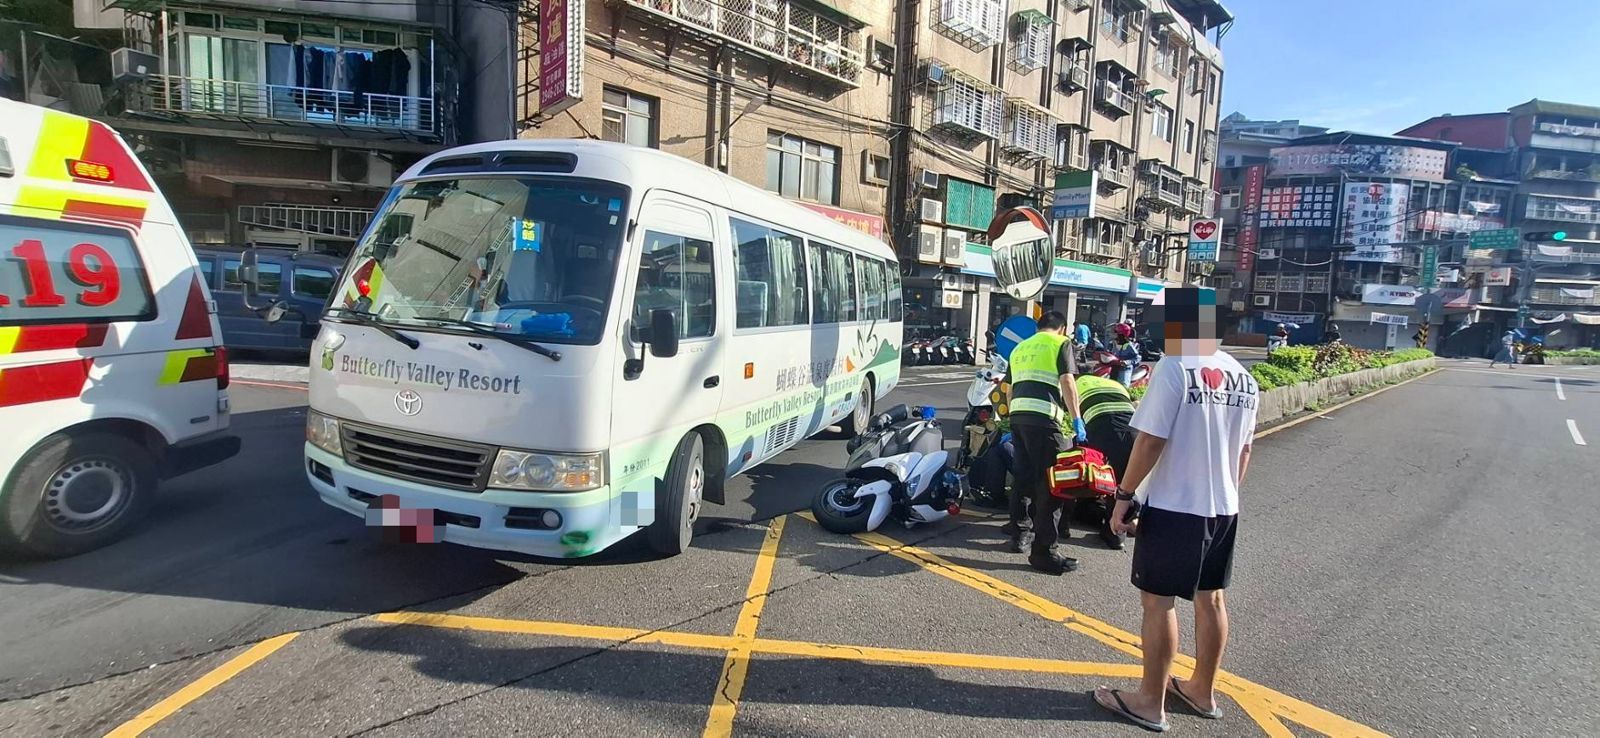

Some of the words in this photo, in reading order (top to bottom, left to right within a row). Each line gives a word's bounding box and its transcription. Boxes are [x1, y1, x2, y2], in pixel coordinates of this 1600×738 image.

[0, 239, 121, 307] 19
[341, 354, 402, 385] Butterfly
[407, 362, 454, 391] Valley
[458, 368, 521, 395] Resort
[1186, 367, 1200, 390] I
[1225, 369, 1256, 395] ME
[745, 400, 782, 429] Butterfly
[784, 396, 803, 414] Valley
